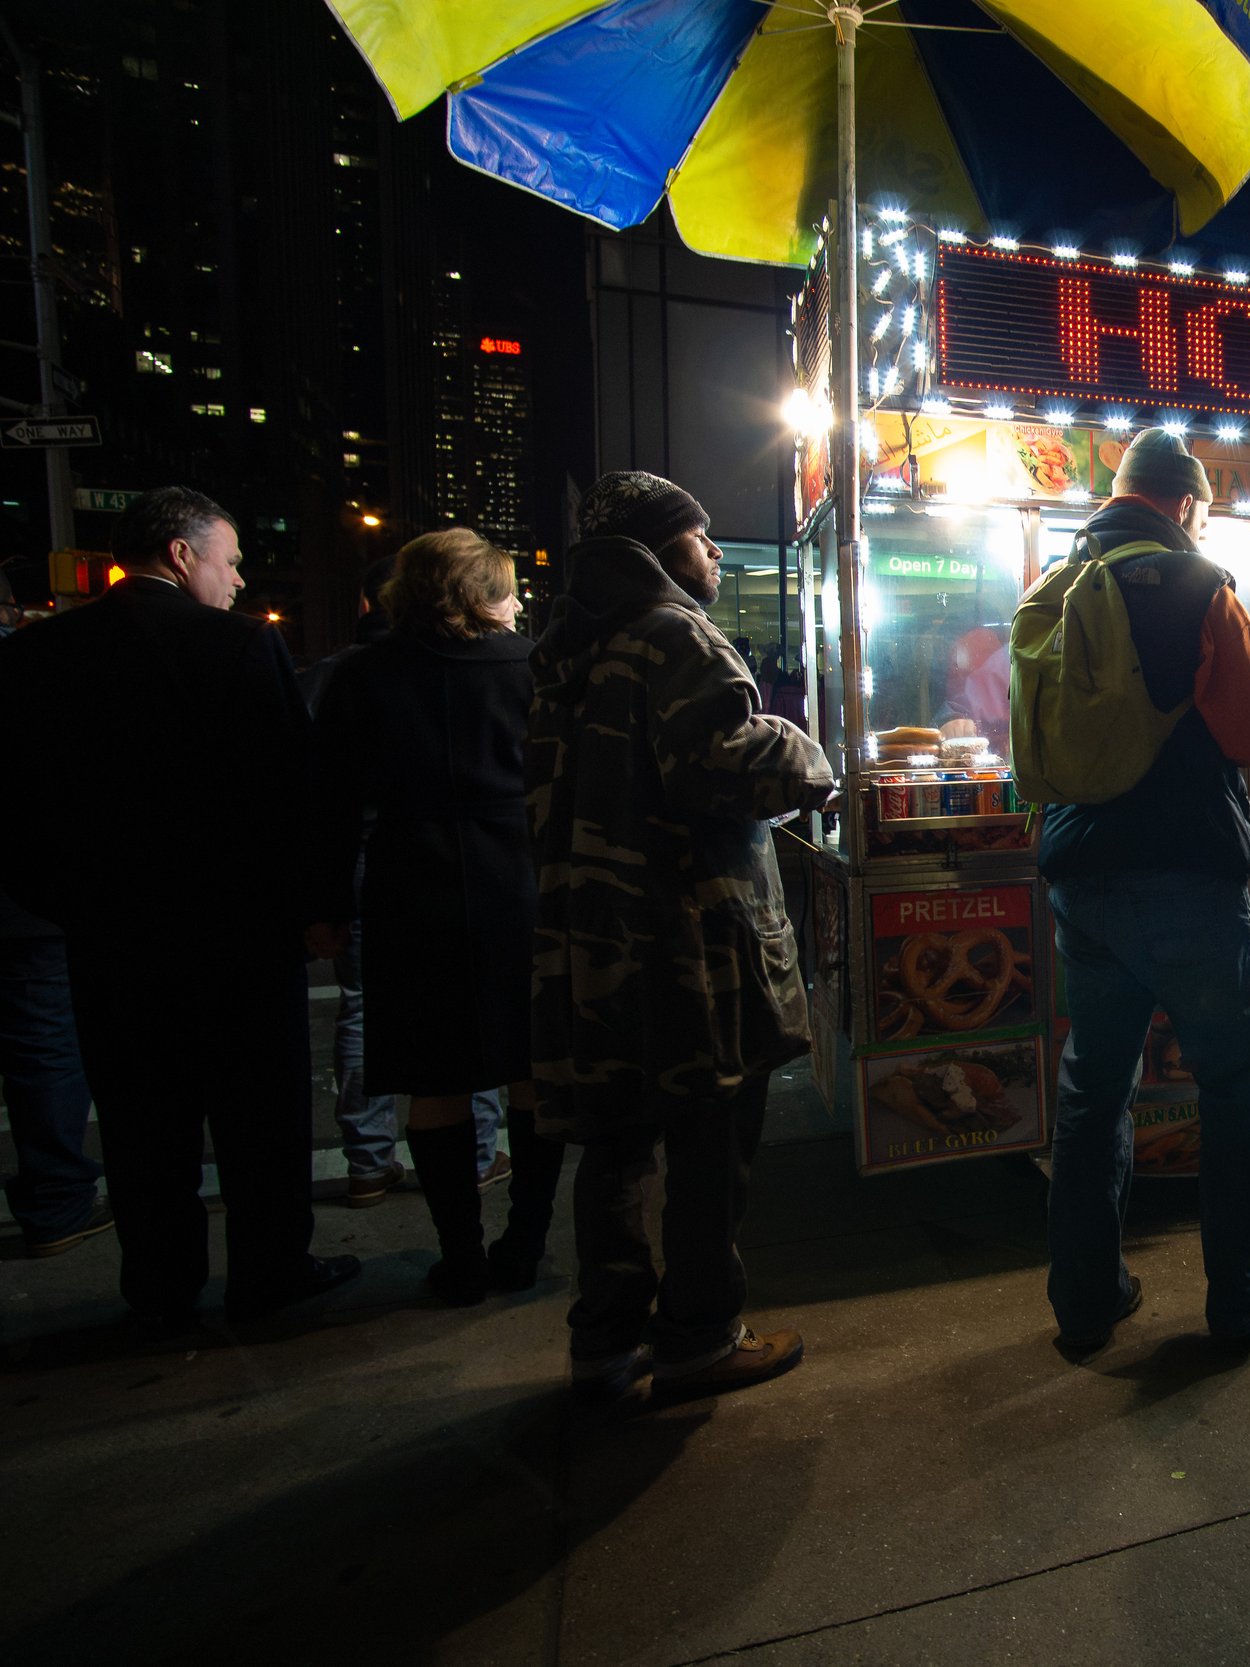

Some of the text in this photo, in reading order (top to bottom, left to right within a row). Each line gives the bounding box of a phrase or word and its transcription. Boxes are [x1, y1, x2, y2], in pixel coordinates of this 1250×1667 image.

[496, 339, 521, 354] UBS
[15, 425, 86, 439] ONE WAY
[1013, 424, 1064, 437] Chicken Gyro
[93, 491, 105, 508] W
[111, 493, 127, 510] 43
[889, 556, 931, 574] Open
[935, 560, 945, 573] 7
[899, 896, 1006, 924] PRETZEL
